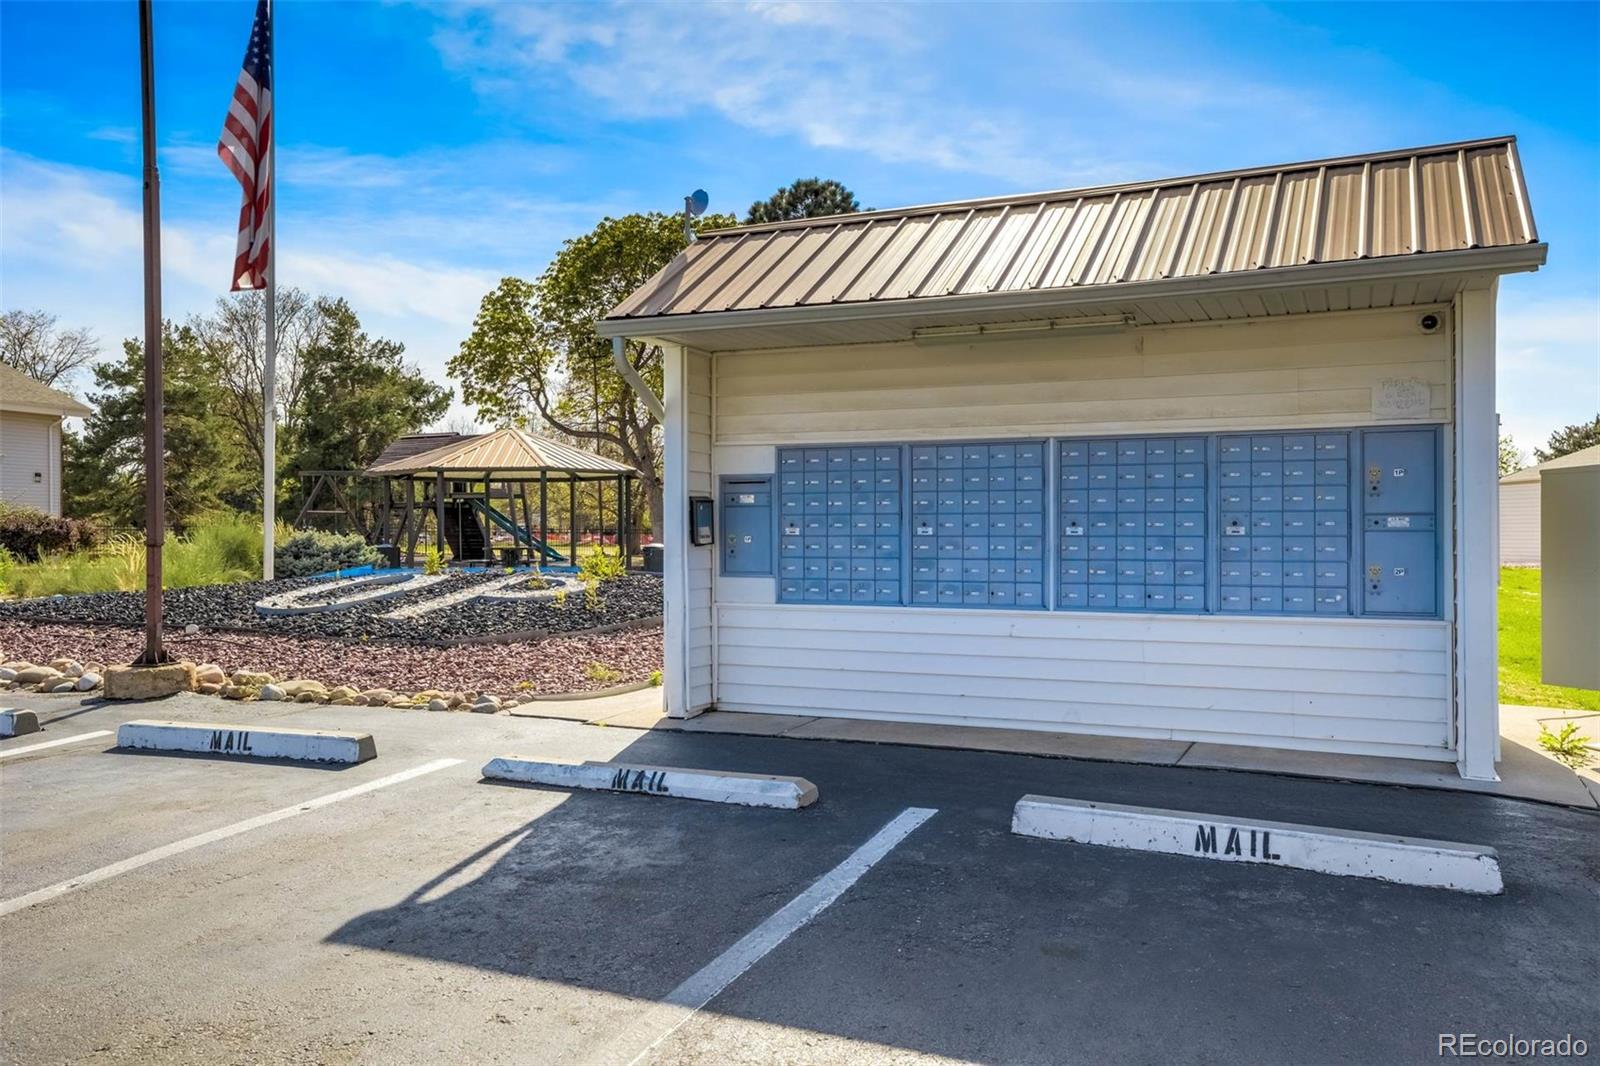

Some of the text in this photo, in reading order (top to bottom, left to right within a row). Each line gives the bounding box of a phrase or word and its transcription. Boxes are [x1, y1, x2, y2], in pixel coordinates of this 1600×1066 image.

[209, 730, 252, 751] MAIL
[611, 768, 669, 792] MAIL
[1194, 824, 1281, 860] MAIL
